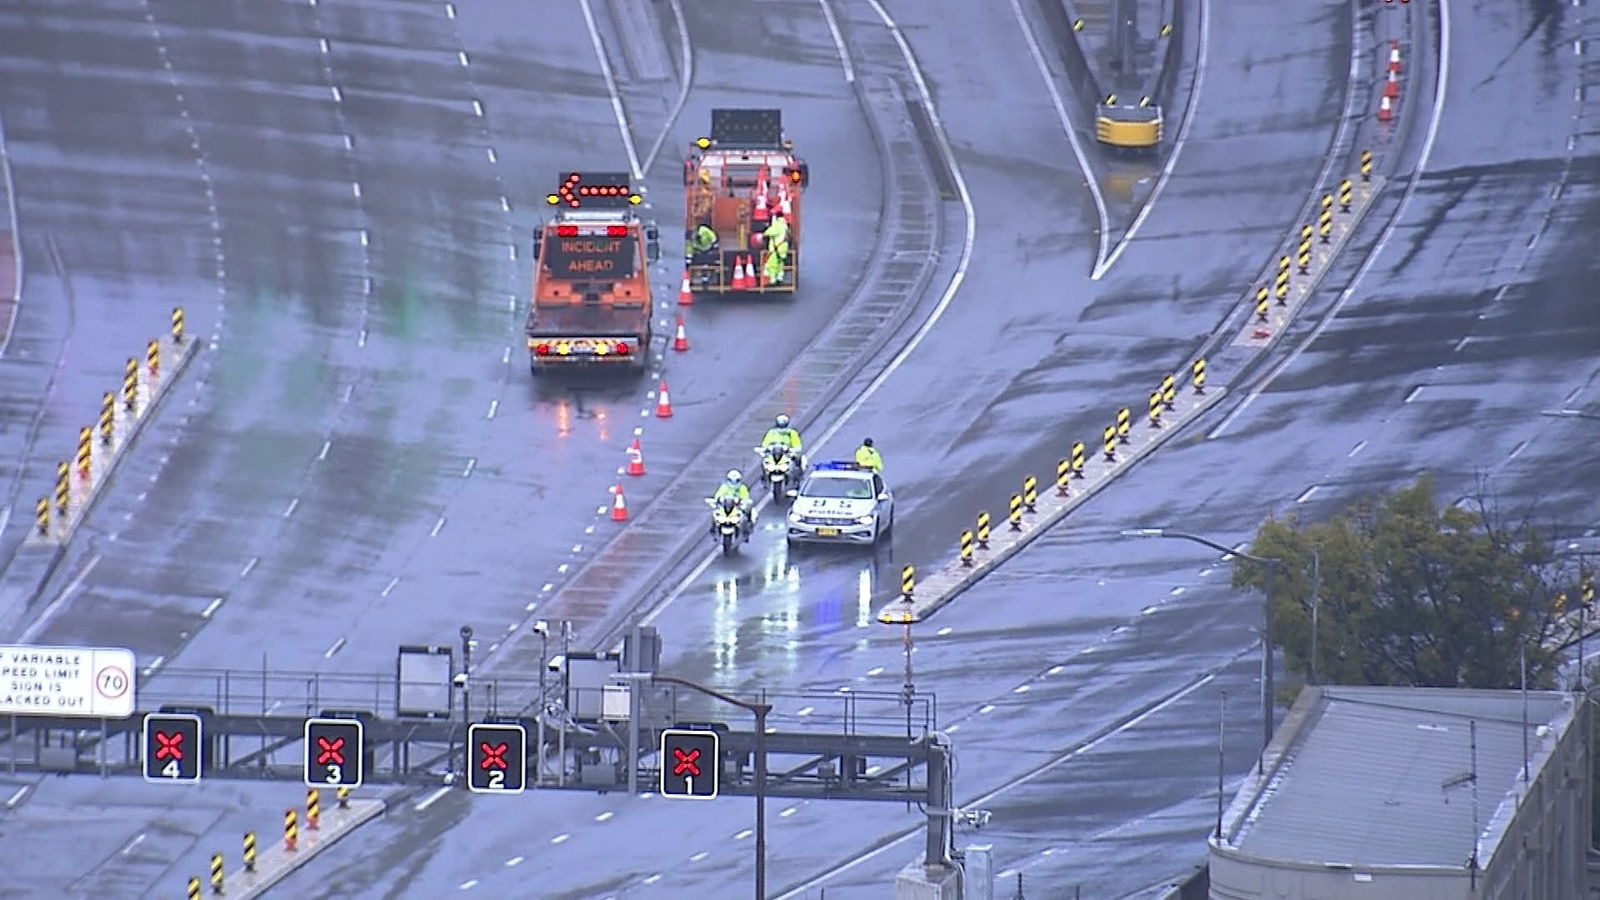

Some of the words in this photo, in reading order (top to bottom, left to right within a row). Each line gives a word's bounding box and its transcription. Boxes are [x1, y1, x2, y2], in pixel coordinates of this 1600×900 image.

[568, 260, 613, 271] AHEAD
[12, 654, 80, 664] VARIABLE
[44, 669, 79, 678] LIMIT
[11, 681, 42, 691] SIGN
[49, 683, 61, 692] IS
[103, 675, 123, 690] 70
[58, 697, 83, 706] OUT
[162, 760, 180, 779] 4
[326, 765, 342, 783] 3
[489, 771, 505, 789] 2
[684, 776, 694, 795] 1
